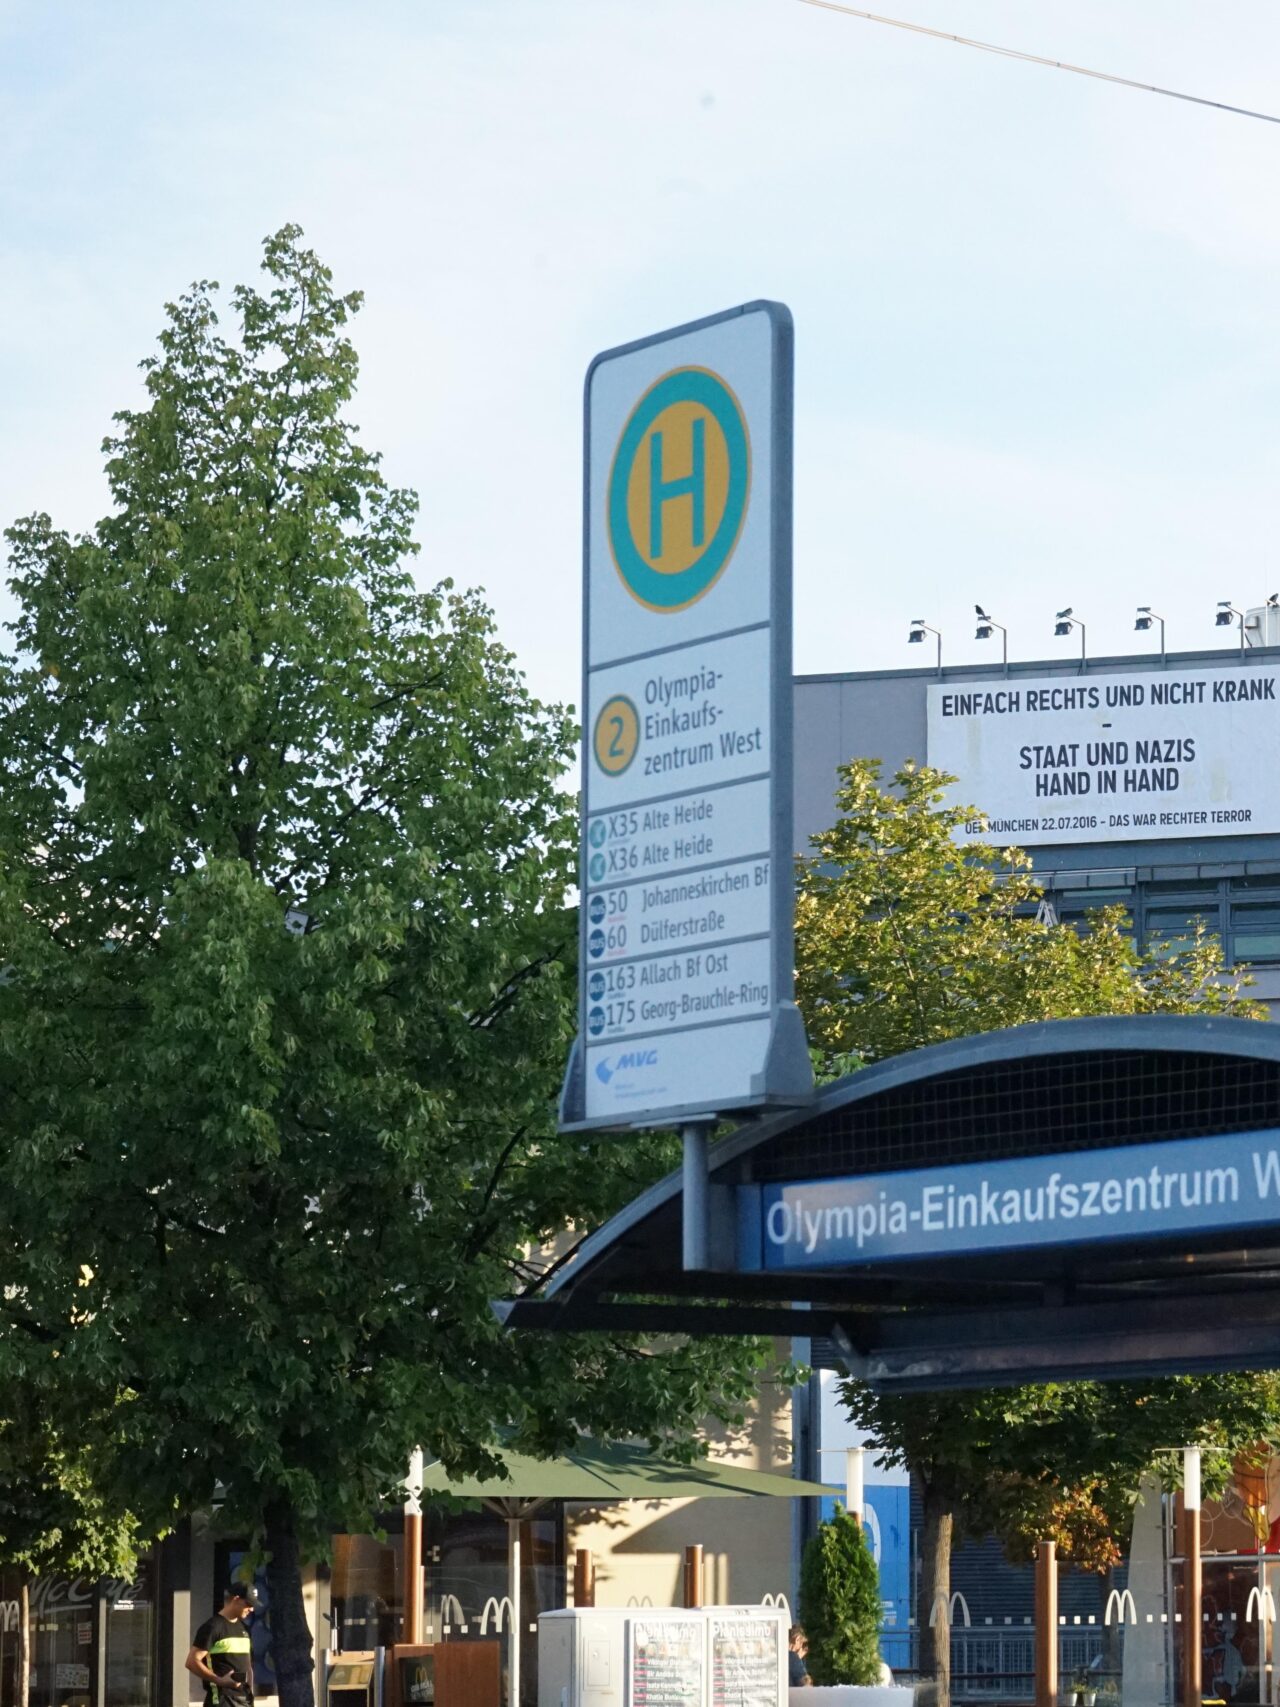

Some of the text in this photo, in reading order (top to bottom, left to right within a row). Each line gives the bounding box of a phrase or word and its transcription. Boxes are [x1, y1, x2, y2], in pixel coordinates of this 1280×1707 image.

[649, 416, 706, 560] H
[644, 665, 723, 707] Olympia-
[942, 678, 1276, 717] EINFACH RECHTS UND NICHT KRANK
[608, 700, 723, 758] 2 Einkaufs-
[644, 727, 762, 776] zentrum West
[1019, 738, 1196, 770] STAAT UND NAZIS
[1035, 767, 1179, 797] HAND IN HAND
[608, 800, 714, 839] X35 Alte Heide
[988, 817, 1039, 833] MÜNCHEN
[1042, 816, 1098, 831] 22.07.2016
[1109, 813, 1130, 827] DAS
[1133, 812, 1156, 826] WAR
[1160, 811, 1209, 825] RECHTER
[1210, 809, 1252, 824] TERROR
[608, 834, 714, 873] X36 Alte Heide
[608, 889, 628, 915] 50
[641, 871, 750, 913] Johanneskirchen
[754, 863, 770, 887] Bf
[607, 925, 627, 950] 60
[641, 910, 725, 944] Dülferstraße
[606, 965, 636, 993] 163
[640, 959, 681, 987] Allach
[686, 955, 702, 978] Bf
[705, 953, 728, 974] Ost
[606, 1000, 636, 1027] 175
[640, 982, 769, 1021] Georg-Brauchle-Ring
[616, 1049, 659, 1070] MVG
[767, 1165, 1239, 1254] Olympia-Einkaufszentrum
